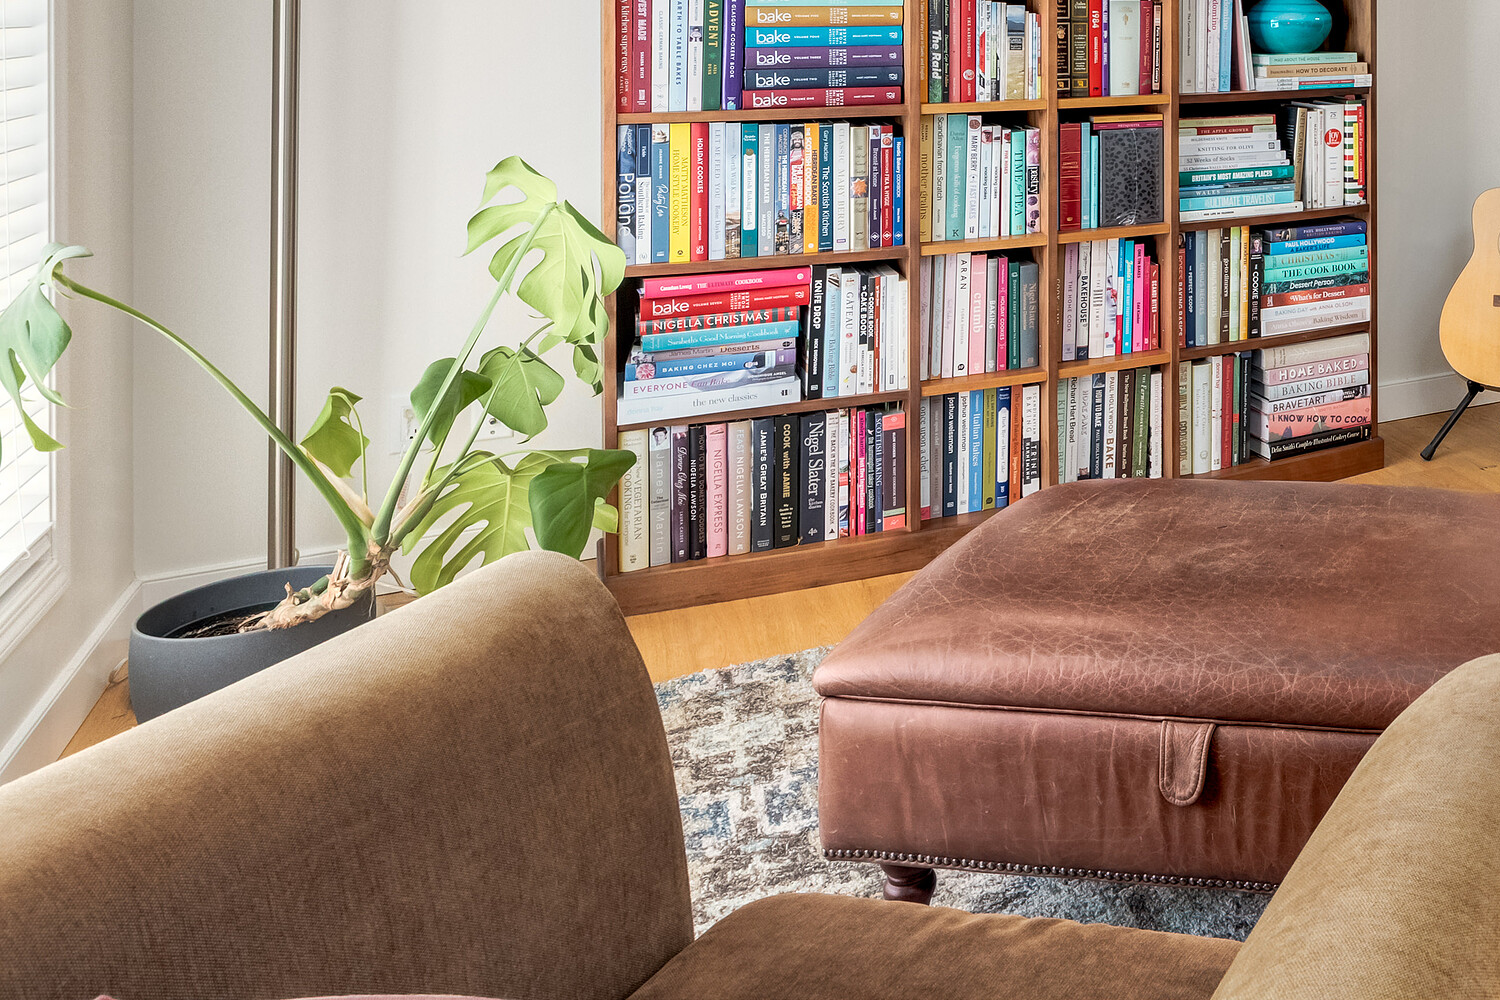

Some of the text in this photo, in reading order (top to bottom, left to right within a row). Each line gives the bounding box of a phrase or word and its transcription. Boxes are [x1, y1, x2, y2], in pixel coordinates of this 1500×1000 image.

[622, 5, 630, 34] kitchen
[708, 1, 719, 48] ADVENT
[757, 9, 792, 22] bake
[1092, 10, 1100, 28] 1984
[638, 19, 647, 41] MADE
[756, 30, 791, 43] bake
[620, 35, 628, 56] super
[756, 51, 791, 64] bake
[932, 30, 942, 80] The Raid
[620, 56, 628, 73] easy
[756, 72, 791, 86] bake
[752, 92, 788, 106] bake
[936, 116, 944, 158] Scandinavian
[1328, 130, 1339, 142] joy
[970, 135, 978, 171] MARY BERRY
[920, 153, 928, 220] mother grains
[936, 176, 944, 201] Scratch
[1191, 174, 1216, 182] BRITAIN'S
[1232, 171, 1254, 180] AMAZING
[618, 172, 634, 236] Poilâne
[672, 149, 680, 235] HOME STYLE COOKERY
[822, 166, 830, 236] The Scottish Kitchen
[1209, 194, 1275, 208] ULTIMATE TRAVELIST
[637, 181, 646, 240] Southern Baking
[1300, 238, 1336, 246] HOLLYWOOD
[1281, 253, 1334, 265] CHRISTMAS
[1282, 262, 1356, 278] THE COOK BOOK
[1290, 281, 1313, 290] Dessert
[1290, 293, 1313, 302] What's
[1322, 290, 1345, 298] Dessert
[652, 299, 690, 314] bake
[813, 280, 822, 330] KNIFE DROP
[1026, 283, 1037, 329] Nigel Slater
[1080, 275, 1088, 323] BAKEHOUSE
[654, 312, 770, 330] NIGELLA CHRISTMAS
[972, 292, 983, 333] crumb
[668, 328, 779, 346] Sarabeth's Good Morning Cookbook
[1279, 358, 1357, 381] HOME BAKED
[1070, 377, 1078, 404] Richard
[1282, 374, 1356, 396] BAKING BIBLE
[692, 398, 706, 407] the
[728, 393, 758, 403] classics
[1095, 404, 1102, 412] TO
[1272, 395, 1326, 412] BRAVETART
[1277, 414, 1304, 422] KNOW
[1306, 415, 1328, 423] HOW
[1330, 415, 1343, 423] TO
[1344, 415, 1368, 424] COOK
[760, 430, 768, 462] JAMIE'S
[783, 424, 791, 449] COOK
[972, 413, 981, 467] Italian Bakes
[1271, 431, 1360, 454] Delia Smith's Complete Illustrated Cookery Course
[783, 451, 791, 470] with
[804, 421, 824, 496] Nigel Slater
[1030, 445, 1038, 475] TRINE
[1106, 437, 1114, 469] BAKE
[673, 447, 687, 505] Dinner Chez Moi
[736, 429, 744, 538] FEAST NIGELLA LAWSON
[760, 463, 768, 491] GREAT
[782, 471, 790, 498] JAMIE
[656, 453, 665, 553] James Martin
[713, 449, 722, 534] NIGELLA EXPRESS
[634, 478, 642, 540] VEGETARIAN
